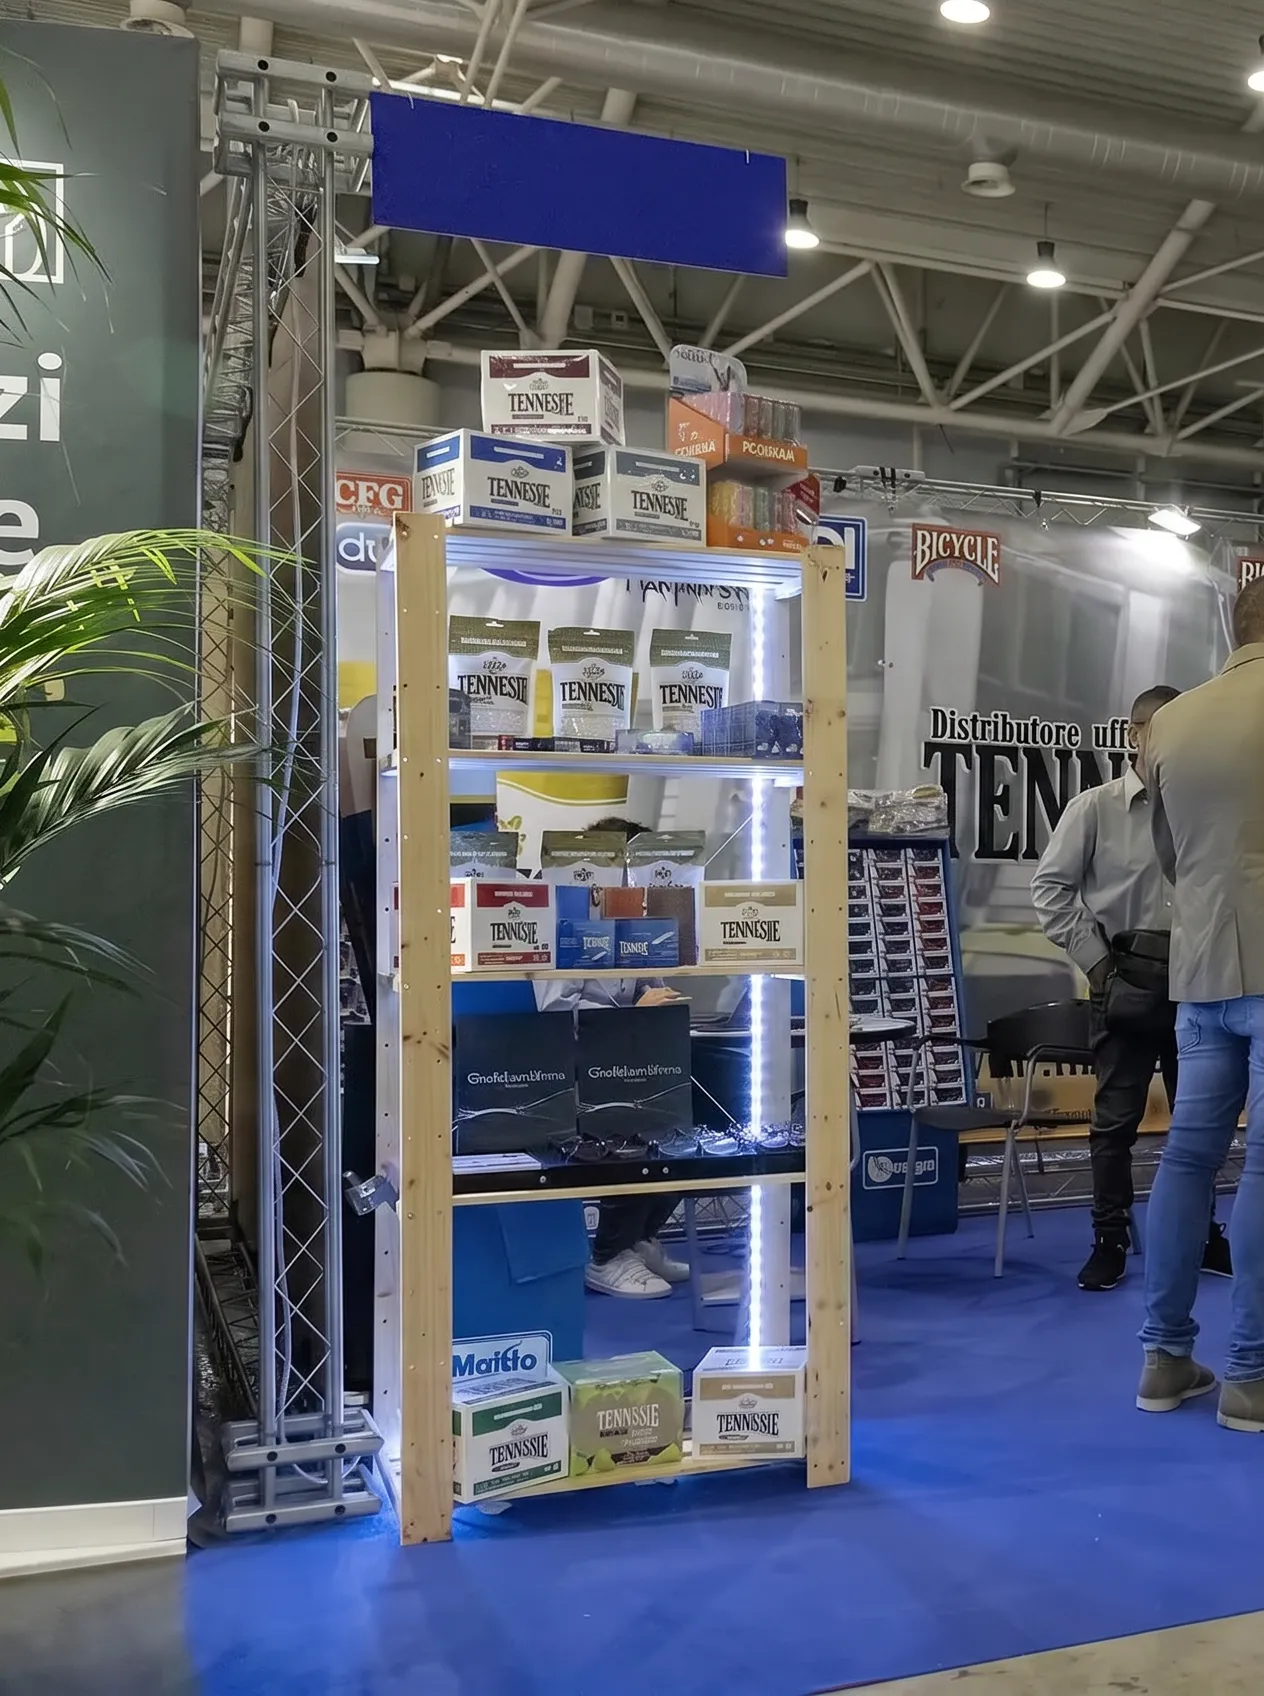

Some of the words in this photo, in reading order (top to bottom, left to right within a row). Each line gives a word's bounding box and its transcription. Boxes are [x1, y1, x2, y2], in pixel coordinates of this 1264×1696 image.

[336, 479, 403, 509] CFG
[915, 529, 999, 584] BICYCLE
[931, 708, 1080, 747] Distributore
